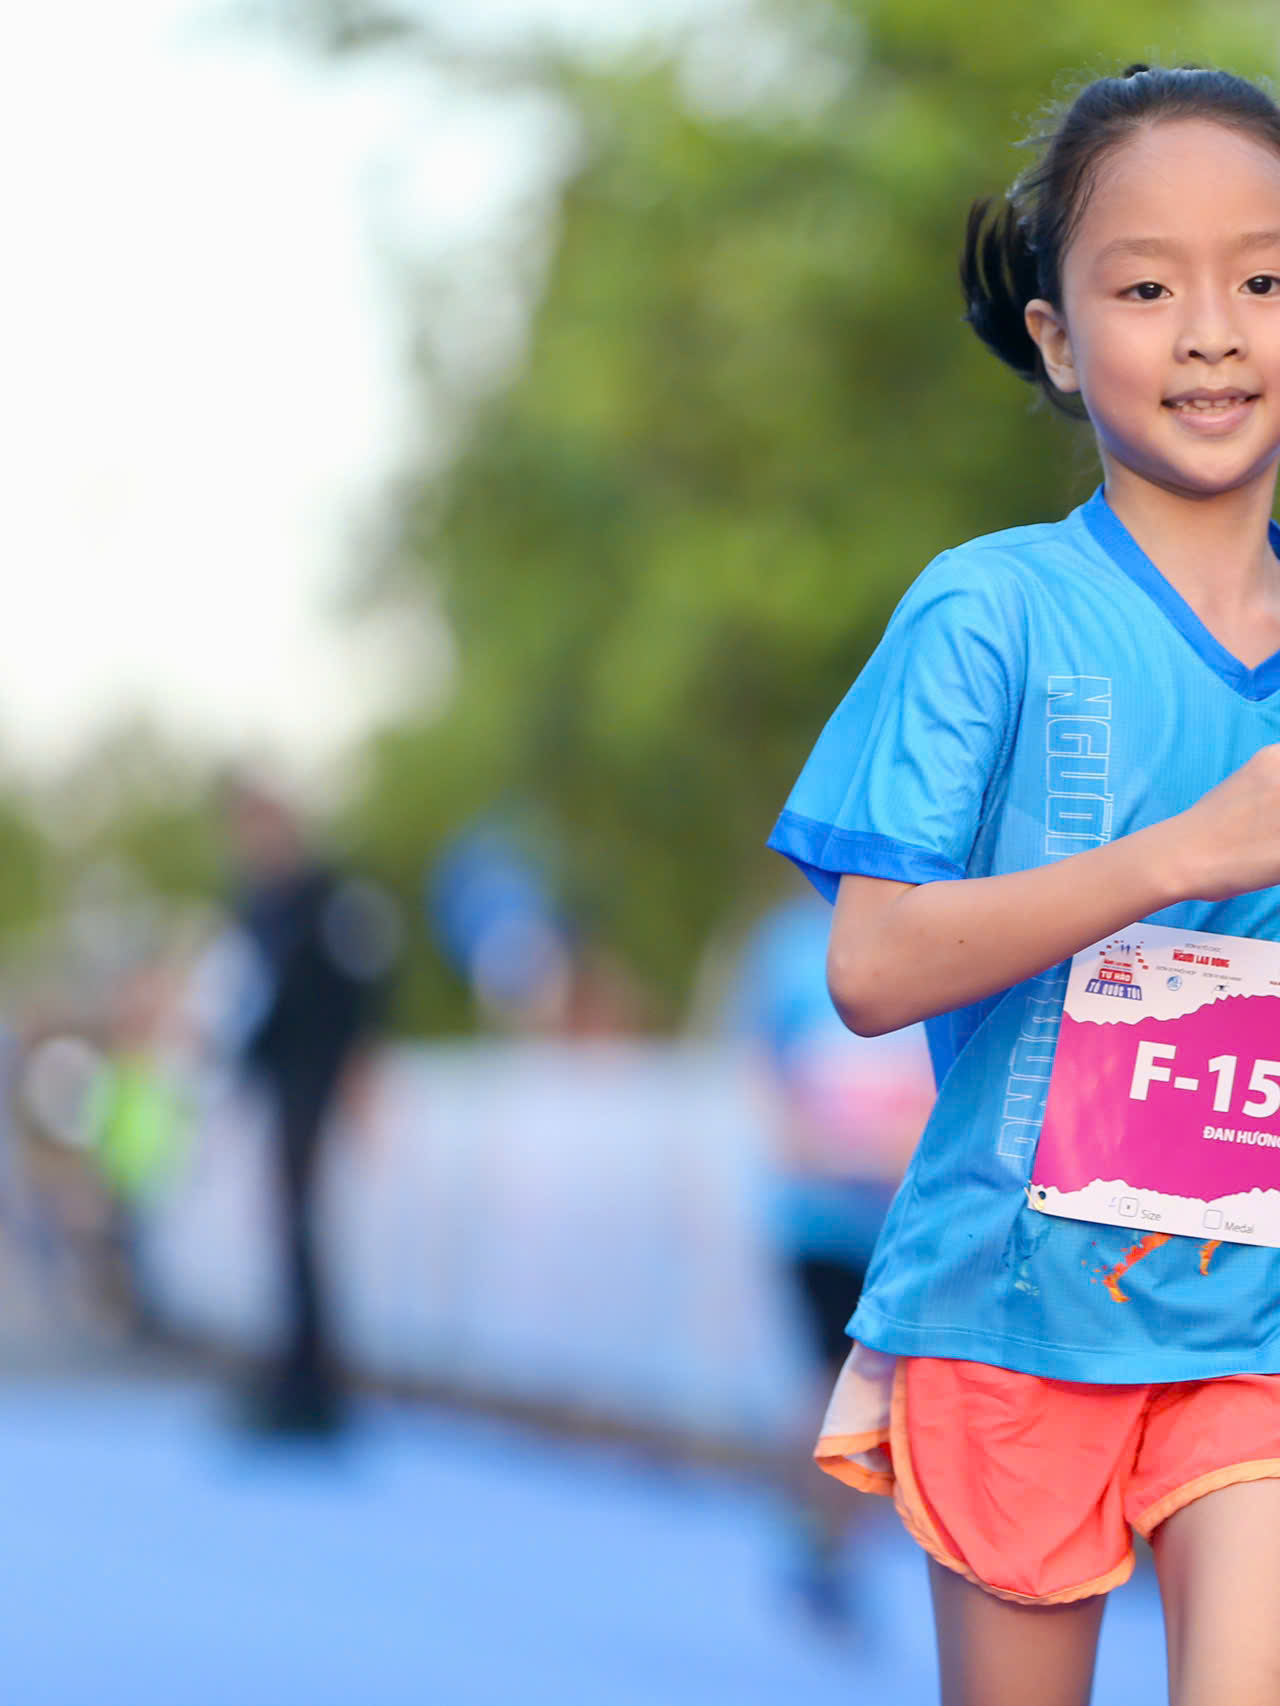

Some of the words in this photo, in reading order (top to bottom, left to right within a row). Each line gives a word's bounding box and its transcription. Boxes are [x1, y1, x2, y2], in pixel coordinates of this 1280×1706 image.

[1203, 1126, 1235, 1142] ĐAN
[1141, 1209, 1161, 1221] Size
[1224, 1222, 1254, 1234] Medal
